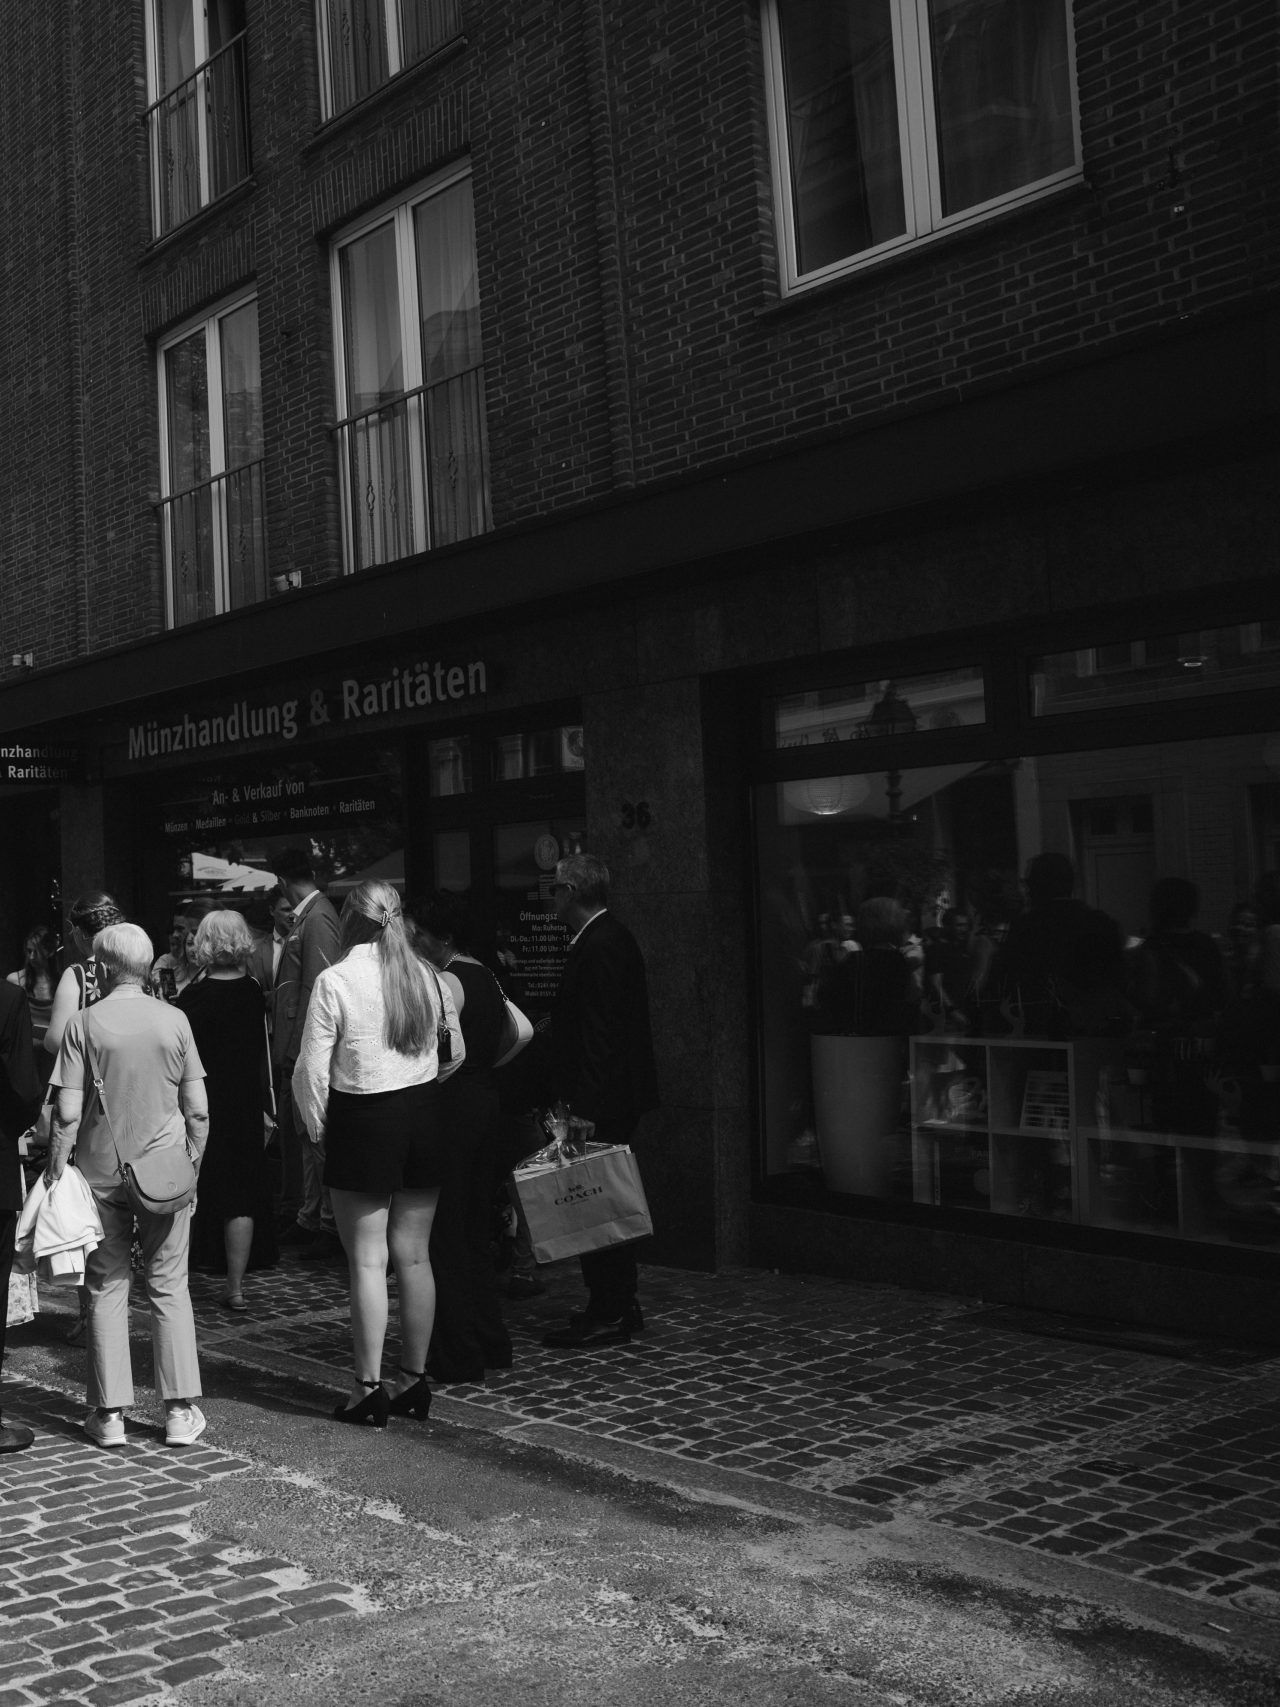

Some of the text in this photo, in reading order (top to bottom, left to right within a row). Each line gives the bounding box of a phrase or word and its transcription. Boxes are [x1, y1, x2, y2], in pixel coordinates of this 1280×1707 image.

[128, 660, 488, 760] Münzhandlung & Raritäten
[8, 765, 67, 778] Raritäten
[212, 779, 305, 805] An- & Verkauf von
[290, 805, 329, 819] Banknoten
[339, 800, 376, 813] Raritäten
[554, 1186, 603, 1206] COACH
